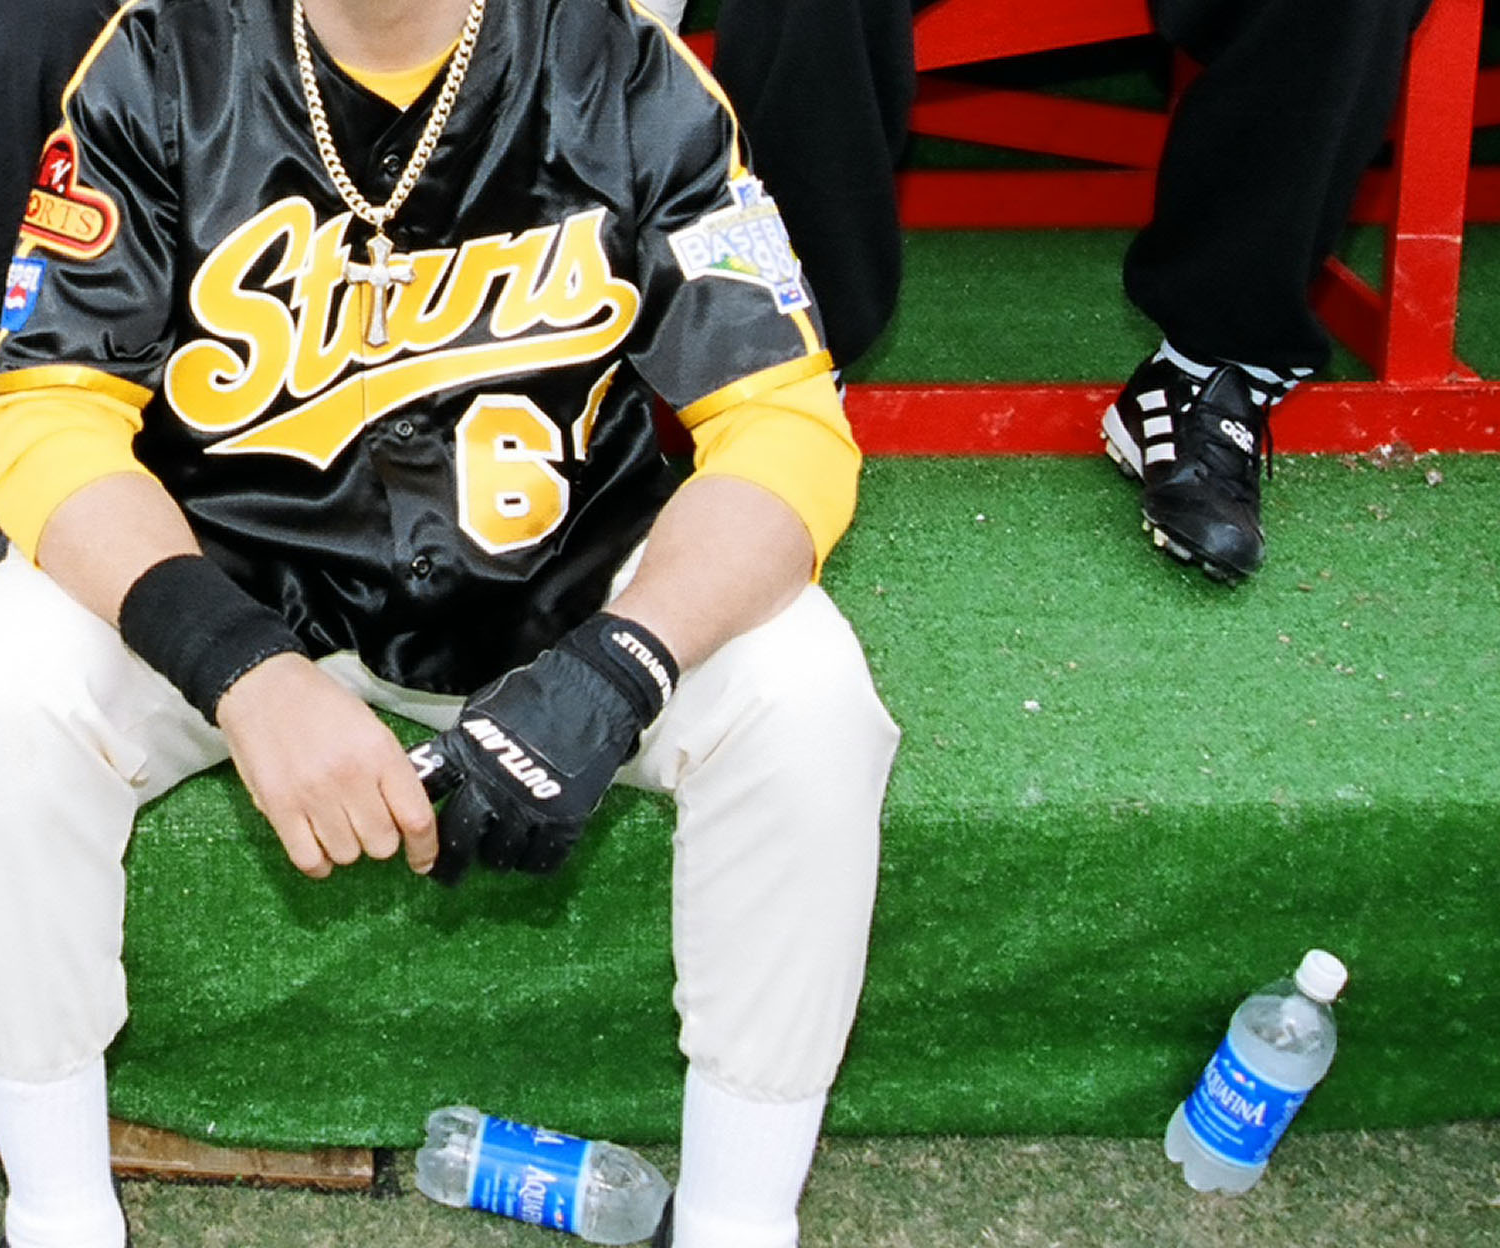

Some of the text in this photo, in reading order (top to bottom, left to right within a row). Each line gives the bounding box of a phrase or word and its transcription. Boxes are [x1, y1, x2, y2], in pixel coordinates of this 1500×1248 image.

[26, 193, 97, 237] ORTS
[164, 195, 640, 433] Stars
[455, 359, 622, 555] 6
[459, 718, 562, 800] OUTLAW
